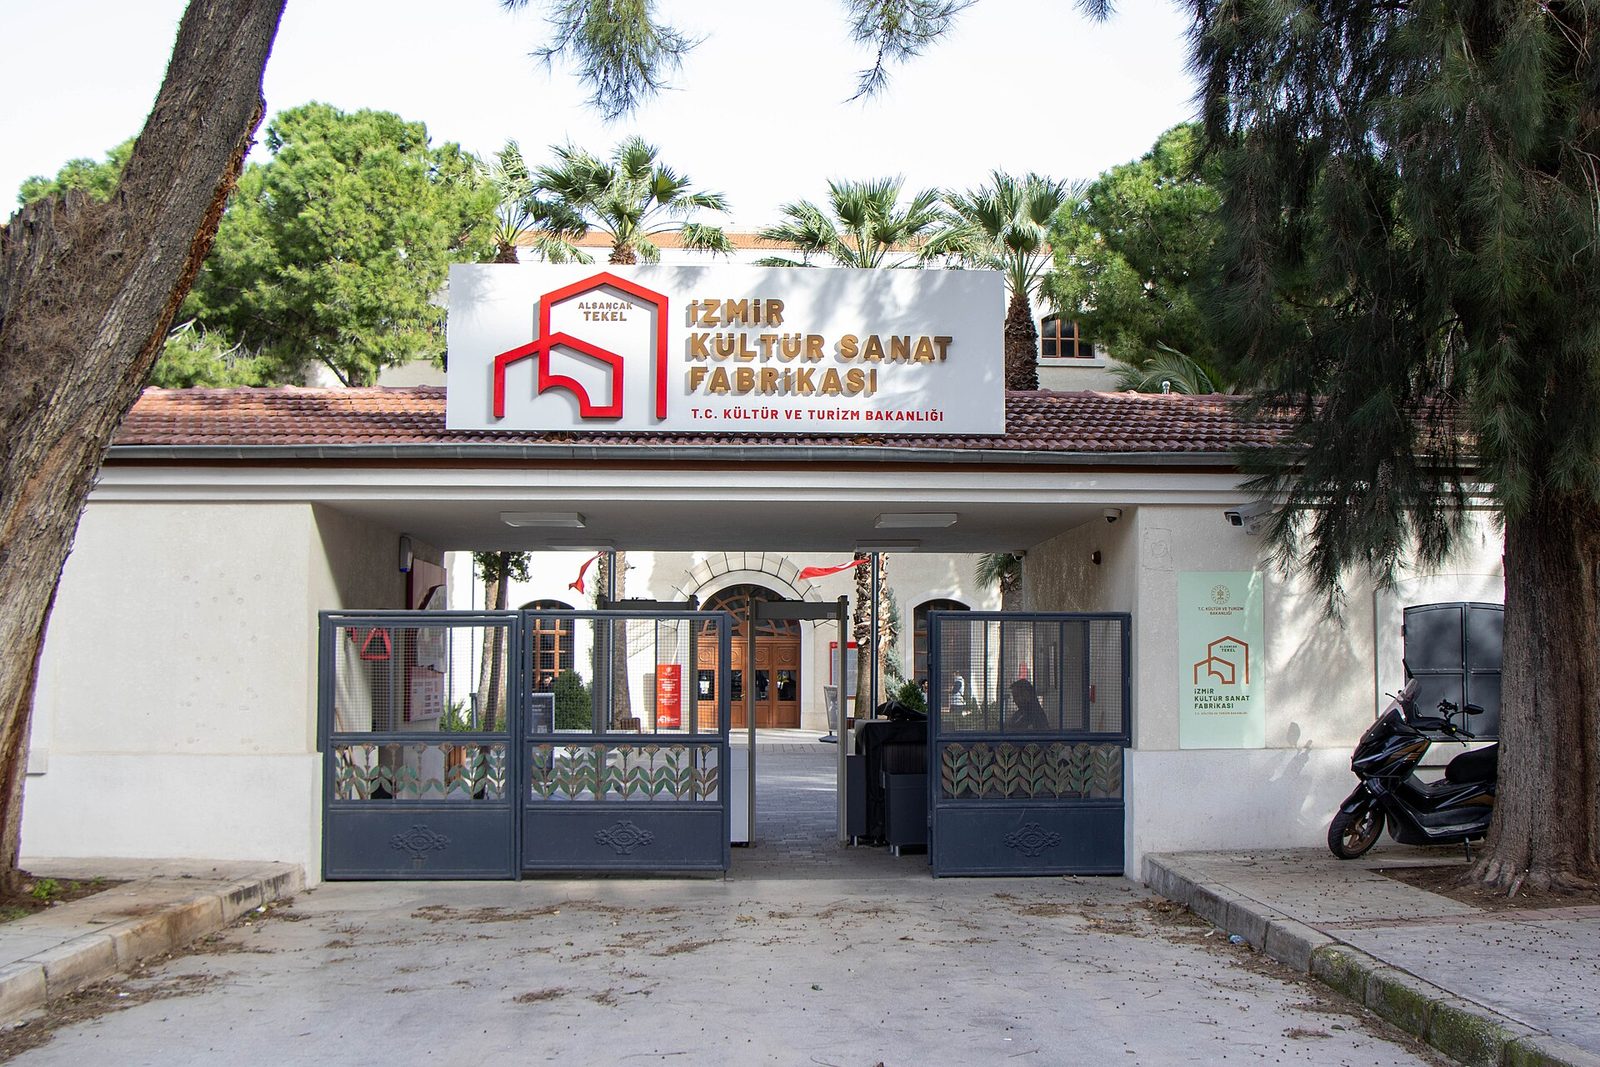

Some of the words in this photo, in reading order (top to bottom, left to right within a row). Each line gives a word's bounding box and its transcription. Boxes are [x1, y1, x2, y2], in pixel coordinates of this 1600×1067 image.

[578, 302, 632, 310] ALSANCAK
[583, 311, 627, 321] TEKEL
[690, 333, 825, 359] KÜLTÜR
[840, 334, 953, 361] SANAT
[690, 367, 878, 394] FABRİKASI
[691, 409, 718, 419] T.C.
[723, 406, 779, 420] KÜLTÜR
[785, 409, 802, 420] VE
[808, 407, 860, 420] TURİZM
[865, 409, 944, 421] BAKANLIĞI
